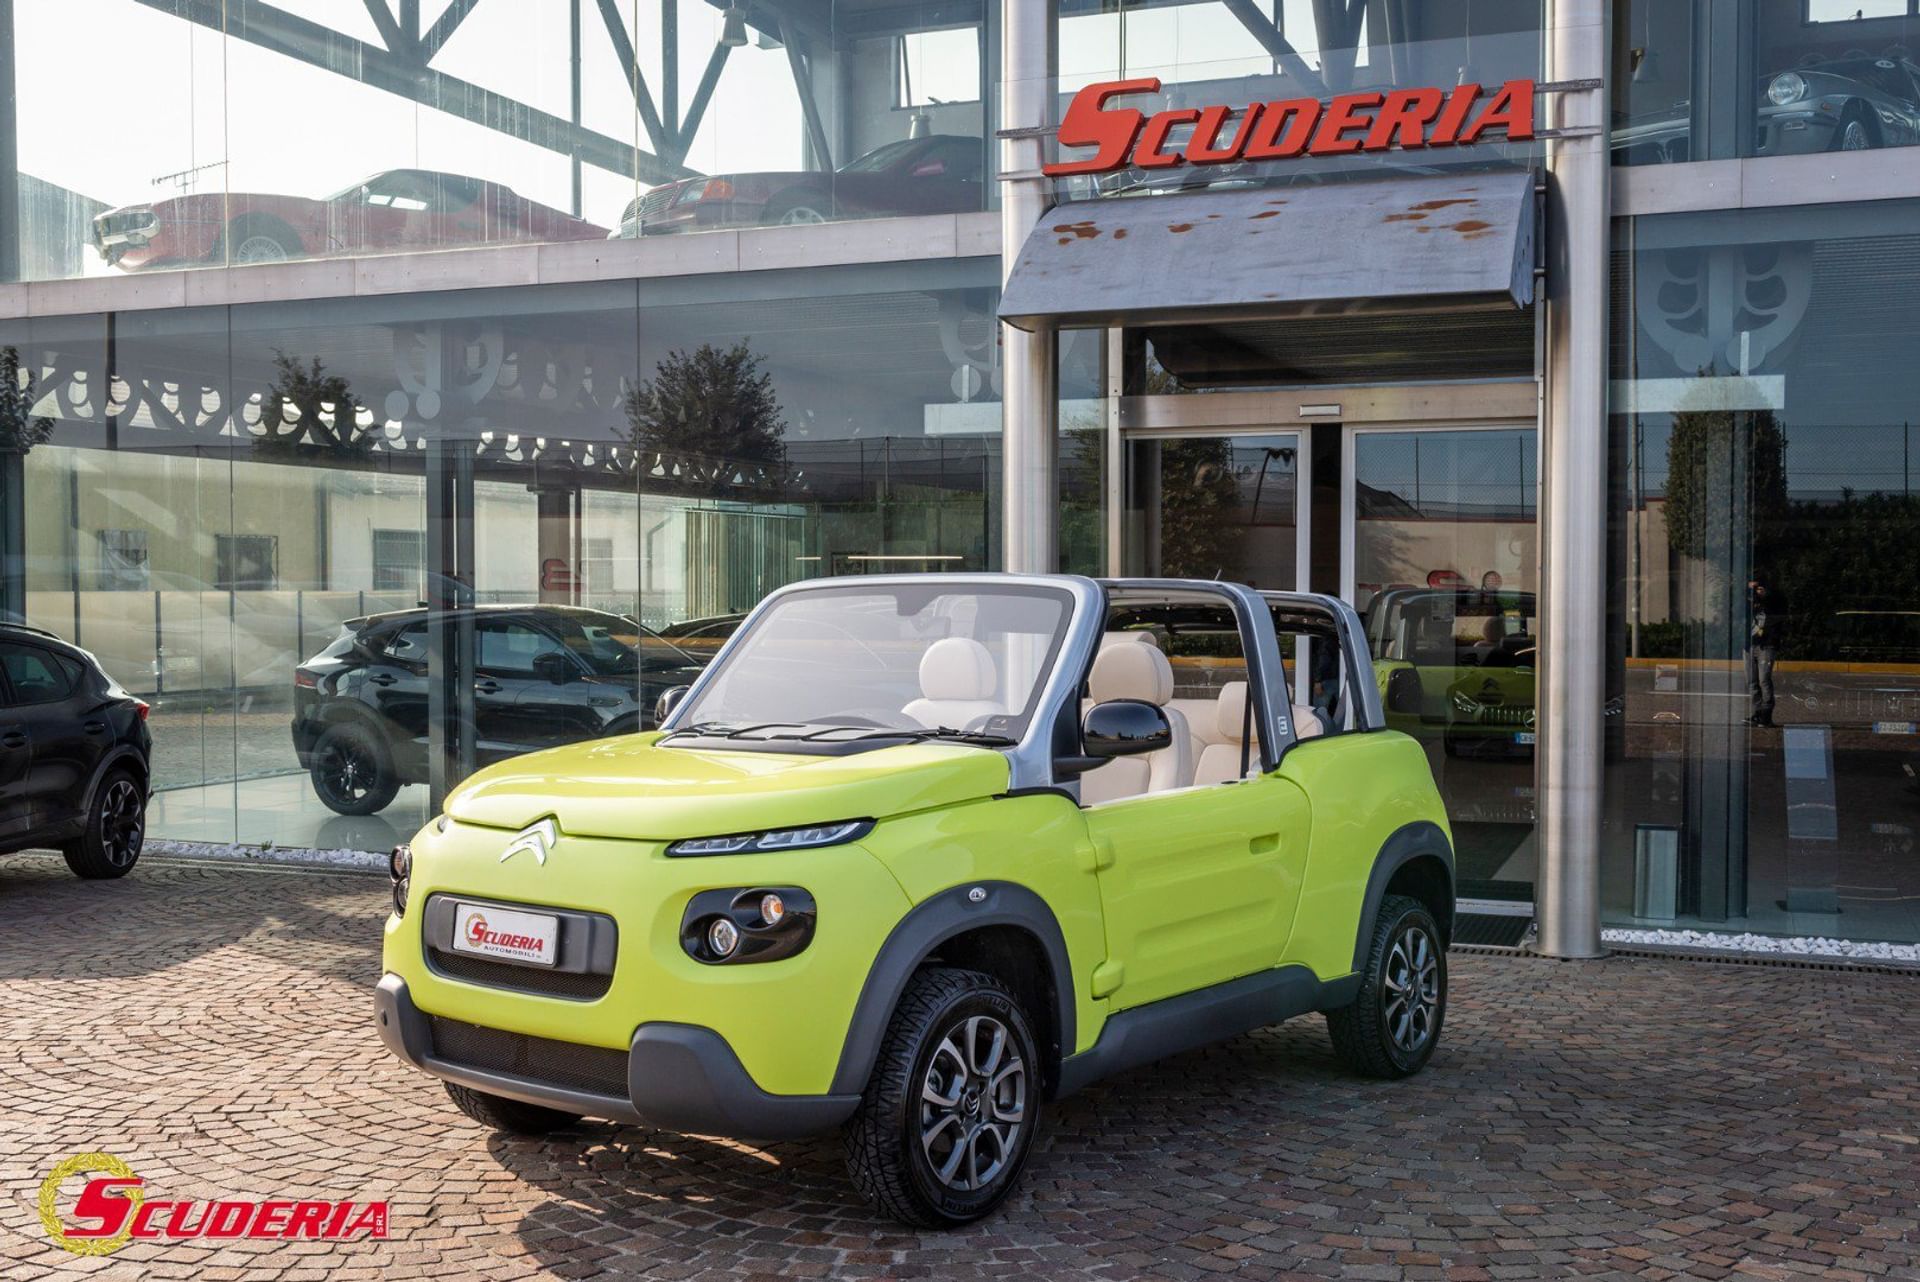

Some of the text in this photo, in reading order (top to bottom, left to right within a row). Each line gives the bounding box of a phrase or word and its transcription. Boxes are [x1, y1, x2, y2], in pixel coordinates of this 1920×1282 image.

[1043, 77, 1536, 176] SCUDERIA
[469, 921, 544, 952] SCUDERIA
[484, 945, 536, 958] AUTOMOBILI
